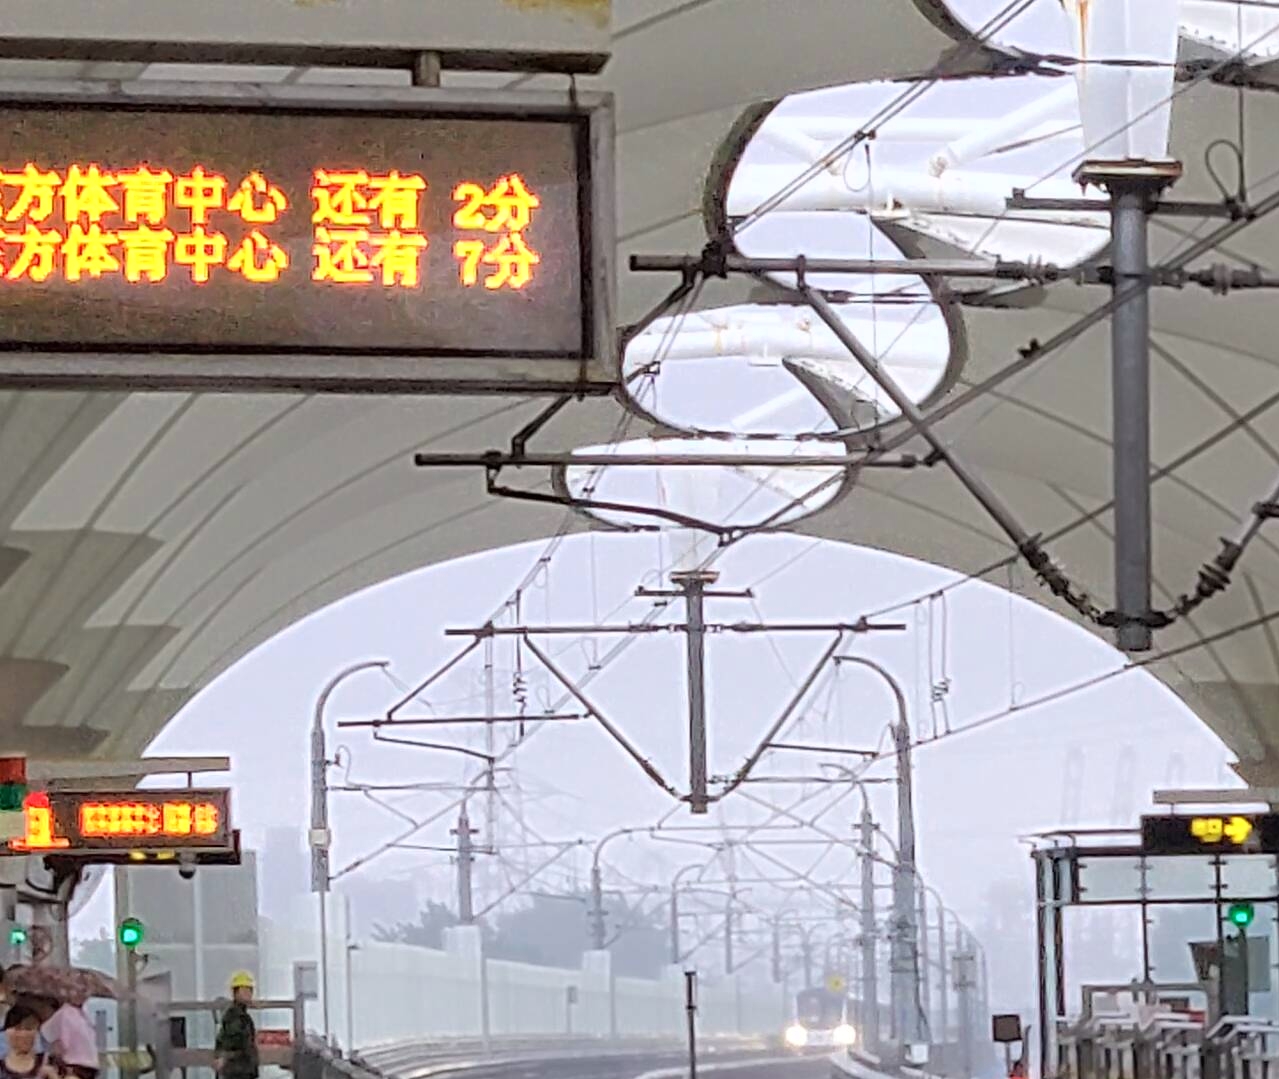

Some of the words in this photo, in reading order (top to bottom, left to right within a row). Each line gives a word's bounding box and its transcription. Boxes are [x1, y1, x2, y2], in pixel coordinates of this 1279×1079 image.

[0, 162, 288, 224] 方体育中心
[311, 168, 429, 230] 还有
[452, 172, 541, 233] 2分
[0, 223, 290, 283] 方体育中心
[311, 227, 429, 288] 还有
[452, 231, 541, 290] 7分
